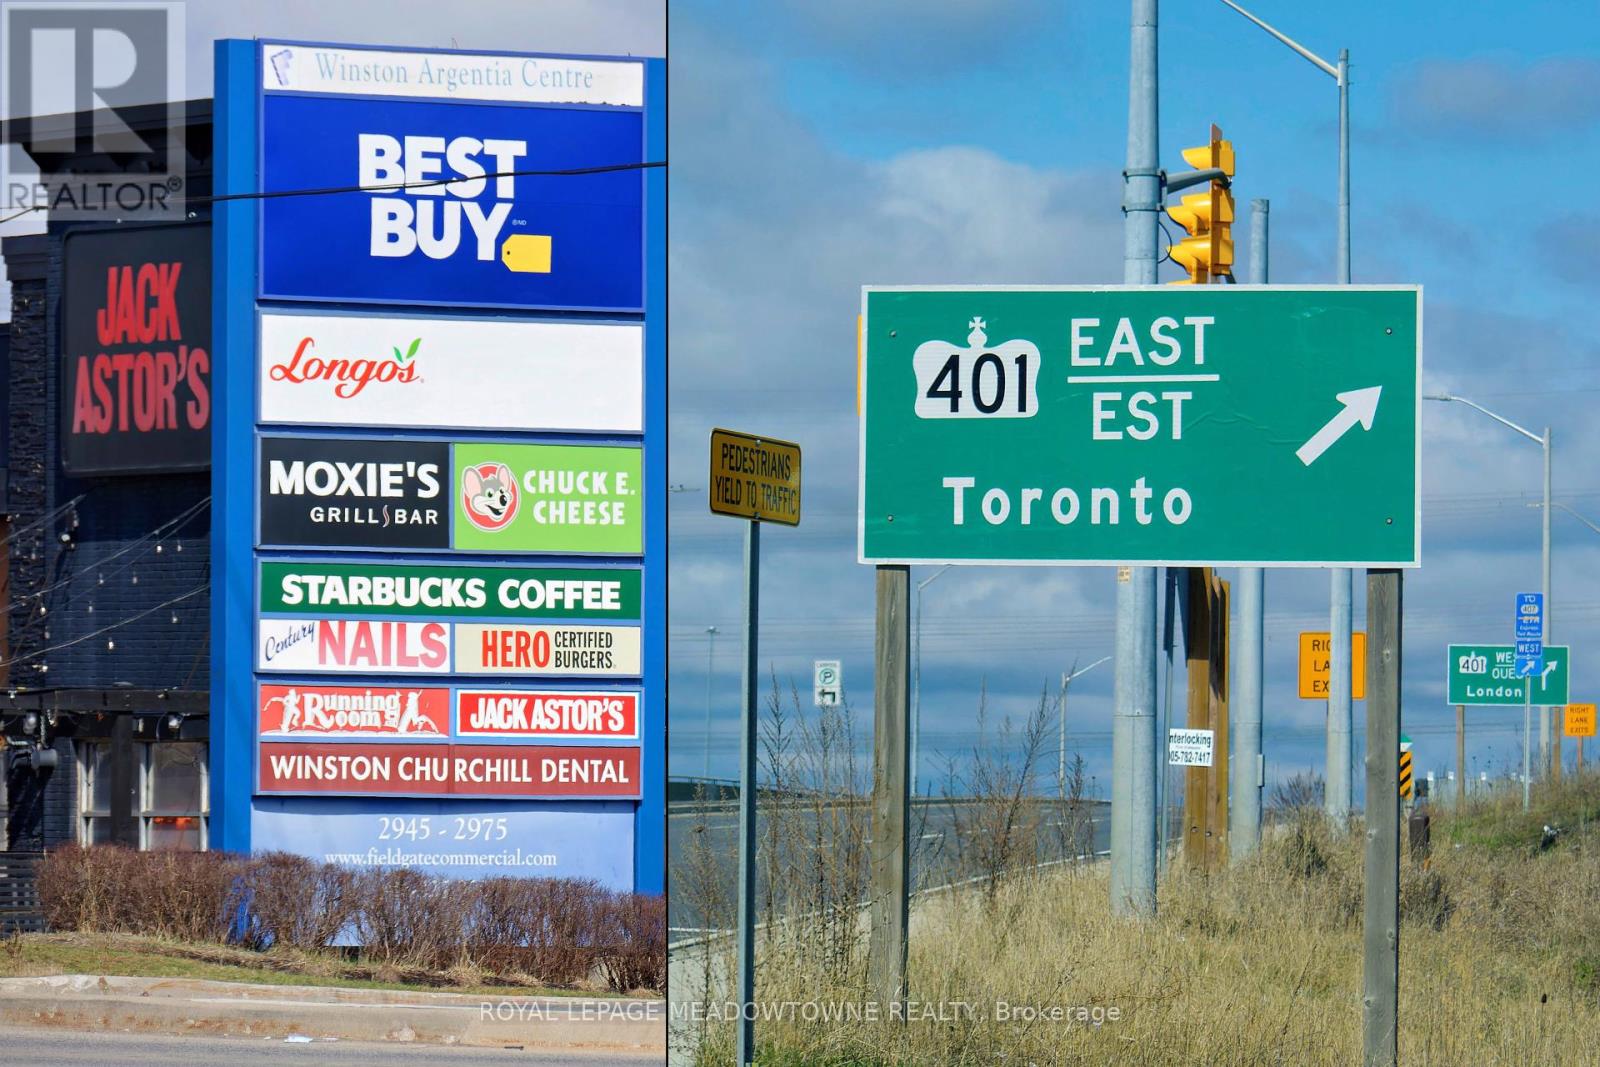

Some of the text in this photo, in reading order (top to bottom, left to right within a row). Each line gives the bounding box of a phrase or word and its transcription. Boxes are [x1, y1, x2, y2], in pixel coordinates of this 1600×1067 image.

[315, 52, 594, 91] Winston Argentia Centre
[358, 133, 527, 199] BEST
[370, 197, 514, 261] BUY
[97, 262, 182, 346] JACK
[1071, 316, 1215, 367] EAST
[72, 345, 210, 434] ASTOR'S
[926, 352, 1028, 414] 401
[1092, 391, 1193, 441] EST
[721, 443, 791, 480] PEDESTRIANS
[269, 460, 440, 498] MOXIE'S
[523, 470, 636, 495] CHUCK E.
[715, 475, 797, 515] YIELD TO TRAFFIC
[942, 476, 1193, 525] Toronto
[310, 506, 438, 525] GRILL BAR
[533, 500, 625, 525] CHEESE
[281, 573, 621, 610] STARBUCKS COFFEE
[264, 619, 448, 669] Century NAILS
[481, 630, 550, 668] HERO
[554, 631, 613, 649] CERTIFIED
[1518, 643, 1540, 653] WEST
[554, 650, 613, 669] BURGERS
[1314, 660, 1330, 672] LA
[1462, 659, 1485, 672] 401
[1492, 667, 1523, 679] OUE
[1496, 652, 1516, 663] WE
[1466, 685, 1522, 697] London
[470, 697, 625, 732] JACK ASTOR'S
[1169, 733, 1211, 748] nterlocking
[270, 755, 629, 783] WINSTON CHURCHILL DENTAL
[1169, 750, 1210, 763] 05-782-7417
[378, 817, 431, 841] 2945
[454, 817, 507, 841] 2975
[325, 848, 558, 868] www.fieldgatecommercial.com
